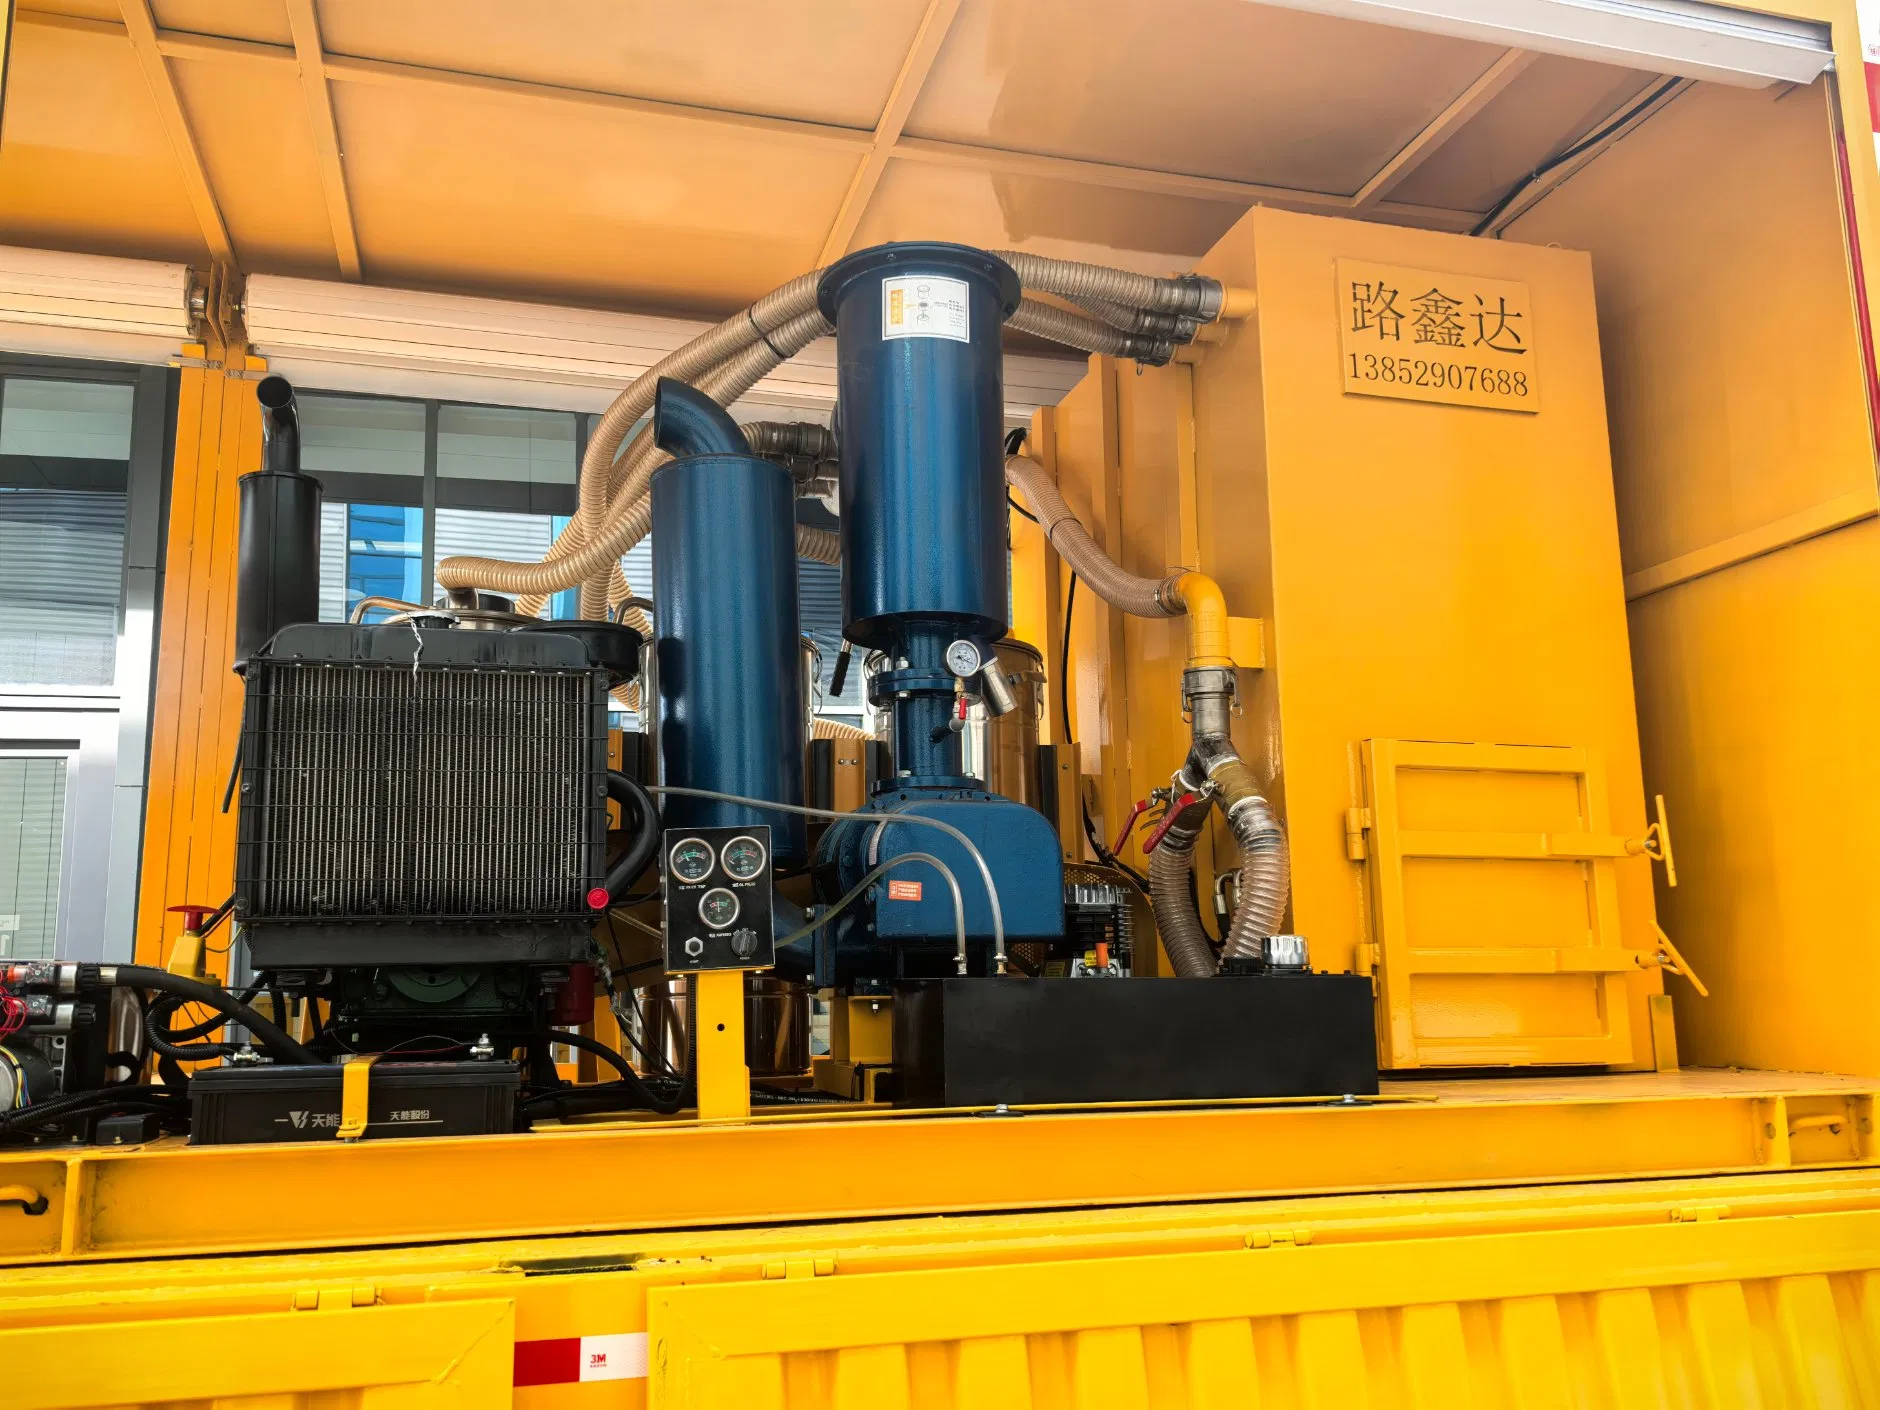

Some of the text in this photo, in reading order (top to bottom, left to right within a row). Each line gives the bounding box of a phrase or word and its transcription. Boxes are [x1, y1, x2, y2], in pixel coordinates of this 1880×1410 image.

[1351, 281, 1528, 355] 路鑫达
[1349, 352, 1529, 397] 13852907688
[590, 1353, 607, 1364] 3M
